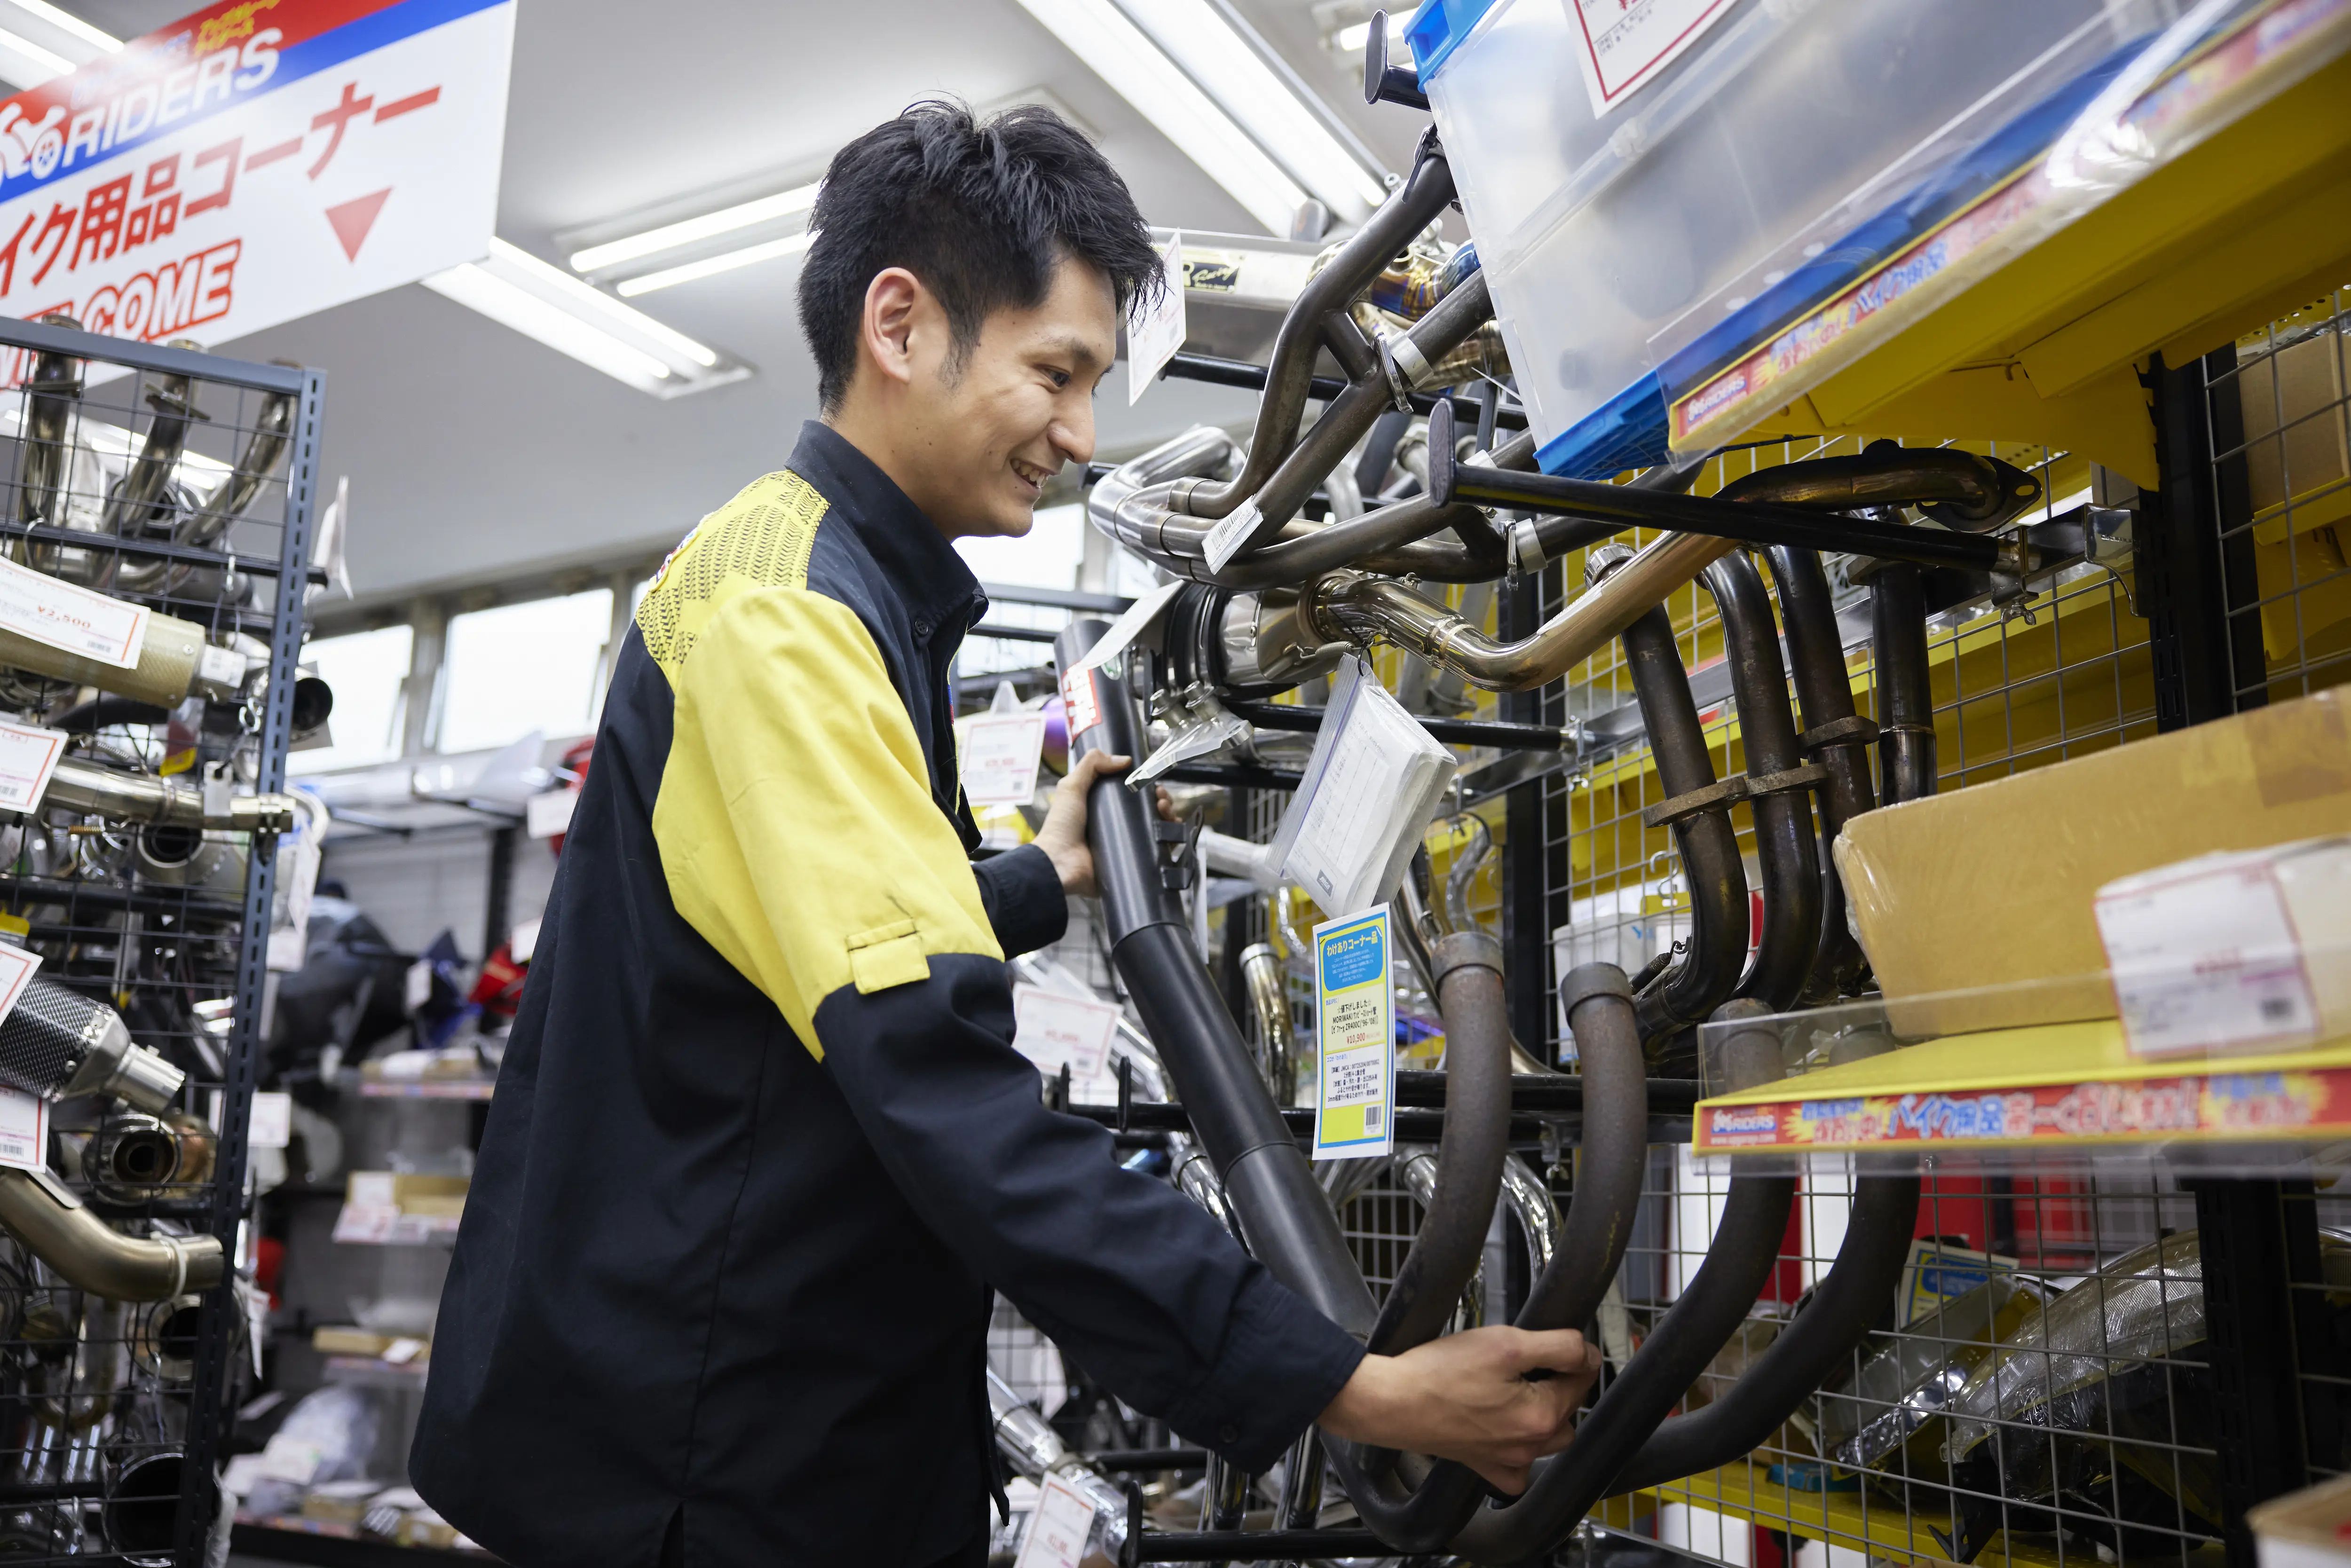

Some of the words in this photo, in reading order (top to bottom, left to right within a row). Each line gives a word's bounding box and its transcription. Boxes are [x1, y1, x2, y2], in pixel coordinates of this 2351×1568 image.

[62, 27, 283, 168] RIDERS
[1333, 1013, 1353, 1024] MORIWAKI
[1347, 1032, 1365, 1044] ¥10,900
